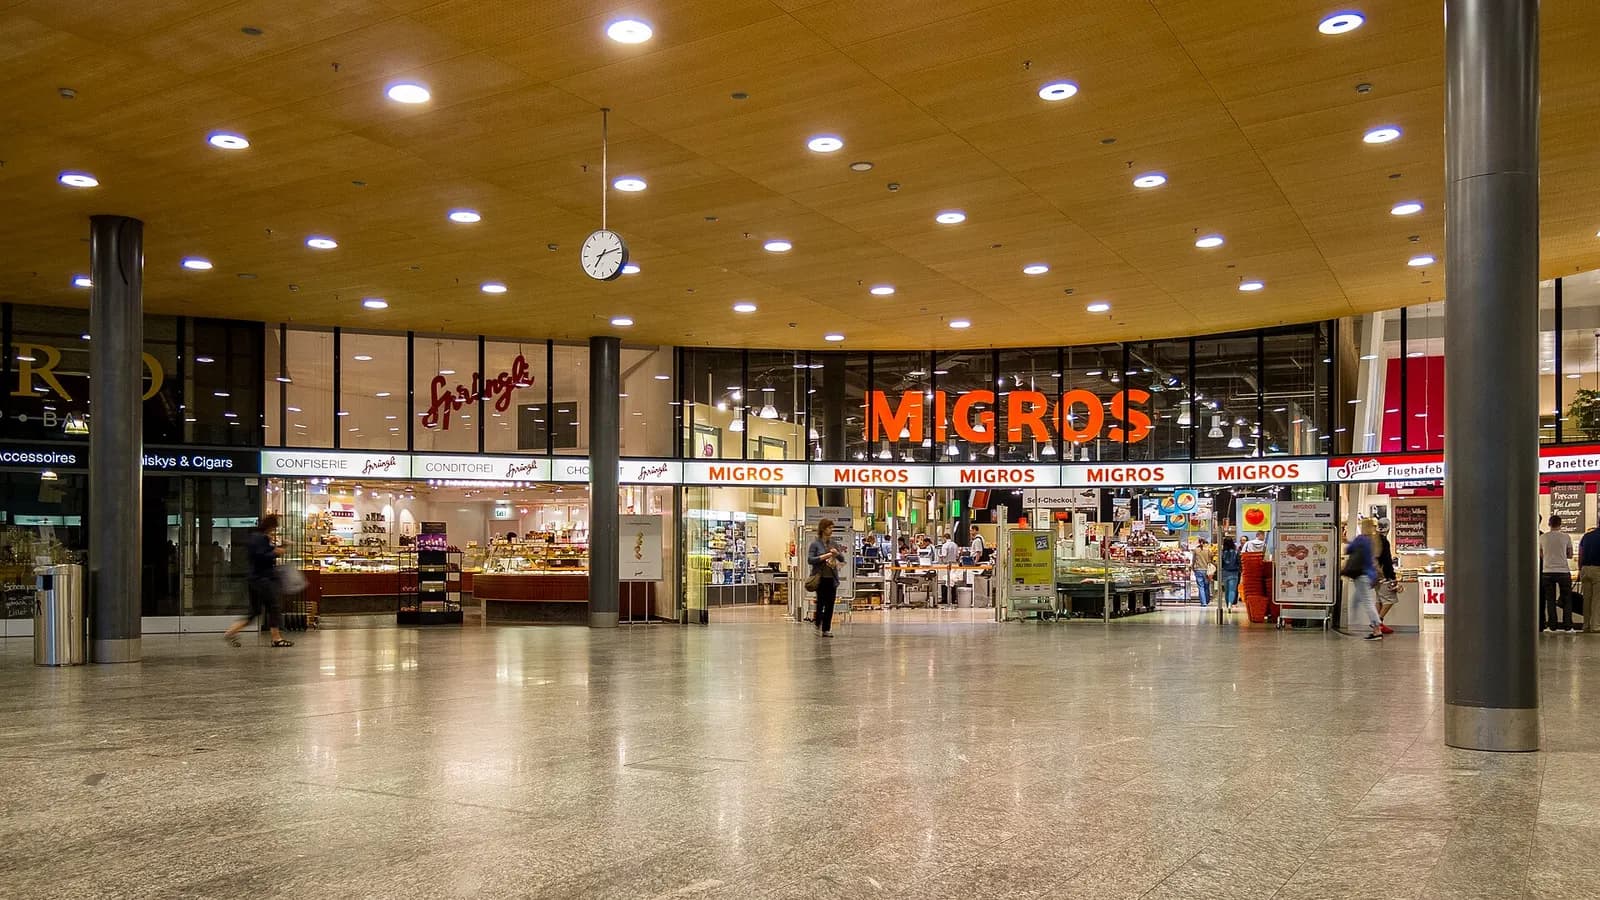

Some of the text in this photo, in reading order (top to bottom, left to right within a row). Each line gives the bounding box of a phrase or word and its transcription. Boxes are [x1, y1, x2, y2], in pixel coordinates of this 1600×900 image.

[864, 389, 1151, 443] MIGROS
[180, 455, 190, 467] &
[193, 456, 233, 469] Cigars
[276, 458, 348, 469] CONFISERIE
[425, 462, 494, 473] CONDITOREI
[1337, 459, 1379, 479] Steiner
[709, 466, 784, 481] MIGROS
[834, 469, 908, 483] MIGROS
[960, 469, 1035, 483] MIGROS
[1087, 468, 1165, 483] MIGROS
[1217, 464, 1299, 480] MIGROS
